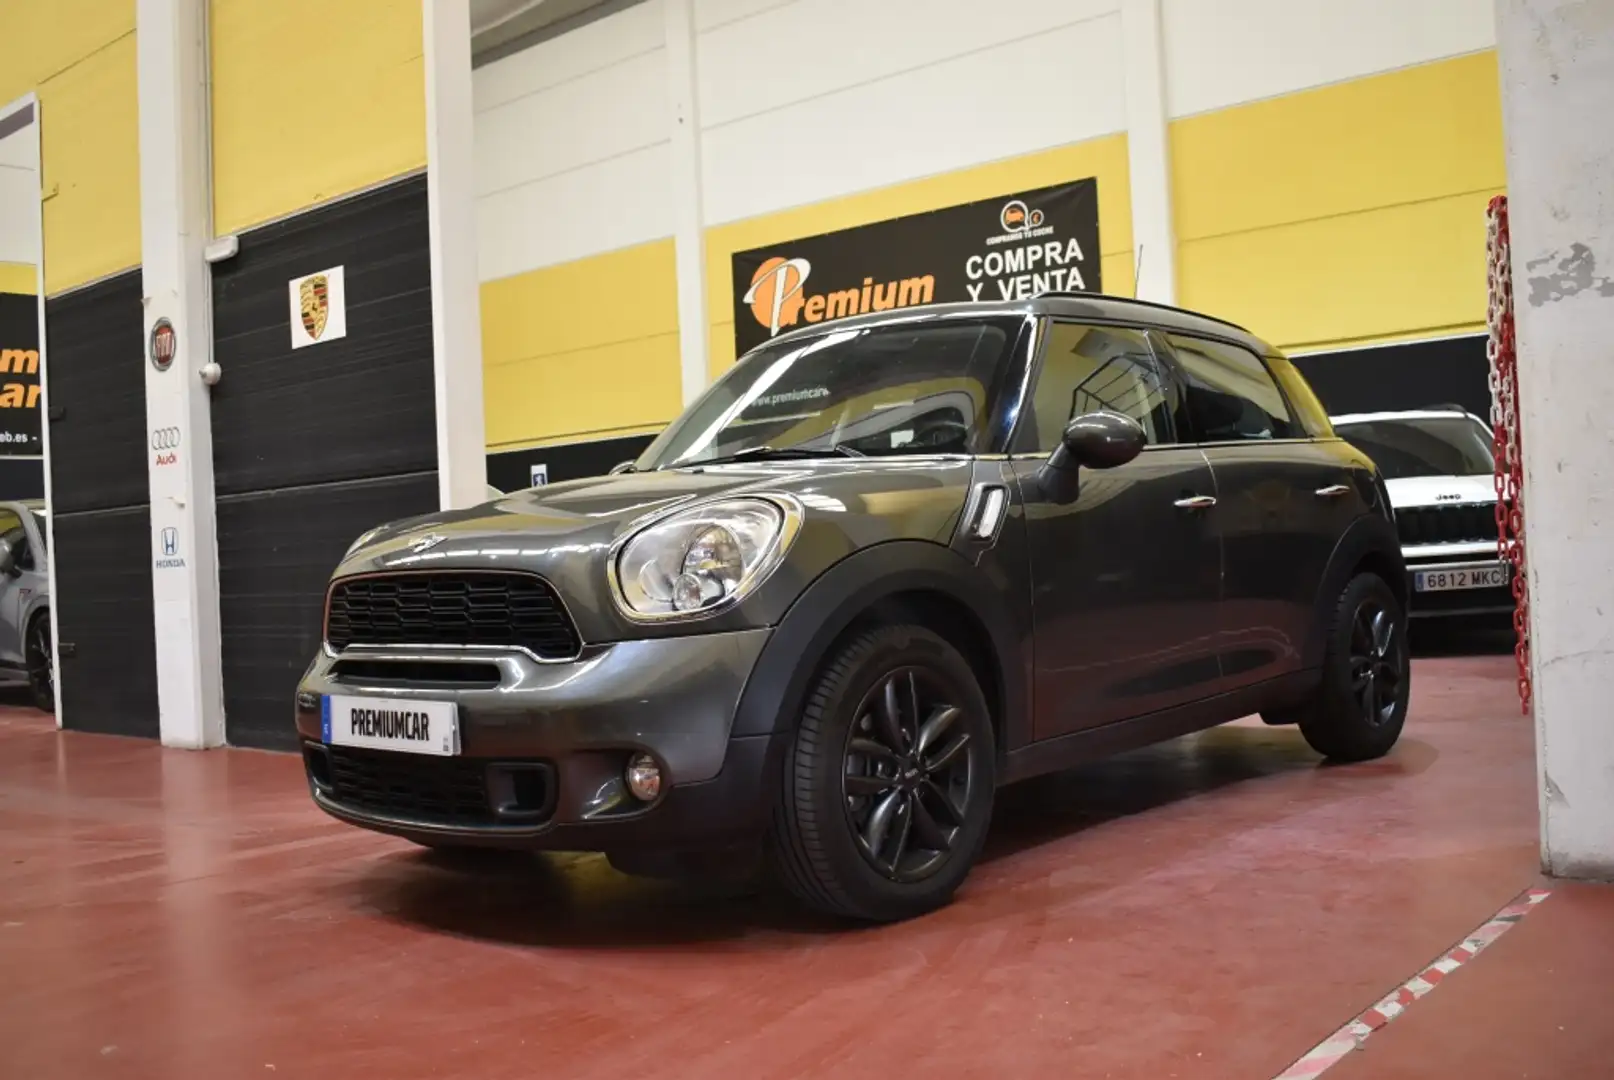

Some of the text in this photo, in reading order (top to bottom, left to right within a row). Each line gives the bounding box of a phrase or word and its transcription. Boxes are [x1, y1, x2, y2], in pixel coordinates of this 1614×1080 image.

[965, 238, 1084, 280] COMPRA
[743, 257, 935, 337] Premium
[966, 267, 1086, 302] Y VENTA
[156, 452, 177, 466] Audi
[156, 558, 187, 569] HONDA
[1427, 569, 1500, 588] 6812 MKC
[351, 708, 430, 741] PREMIUMCAR
